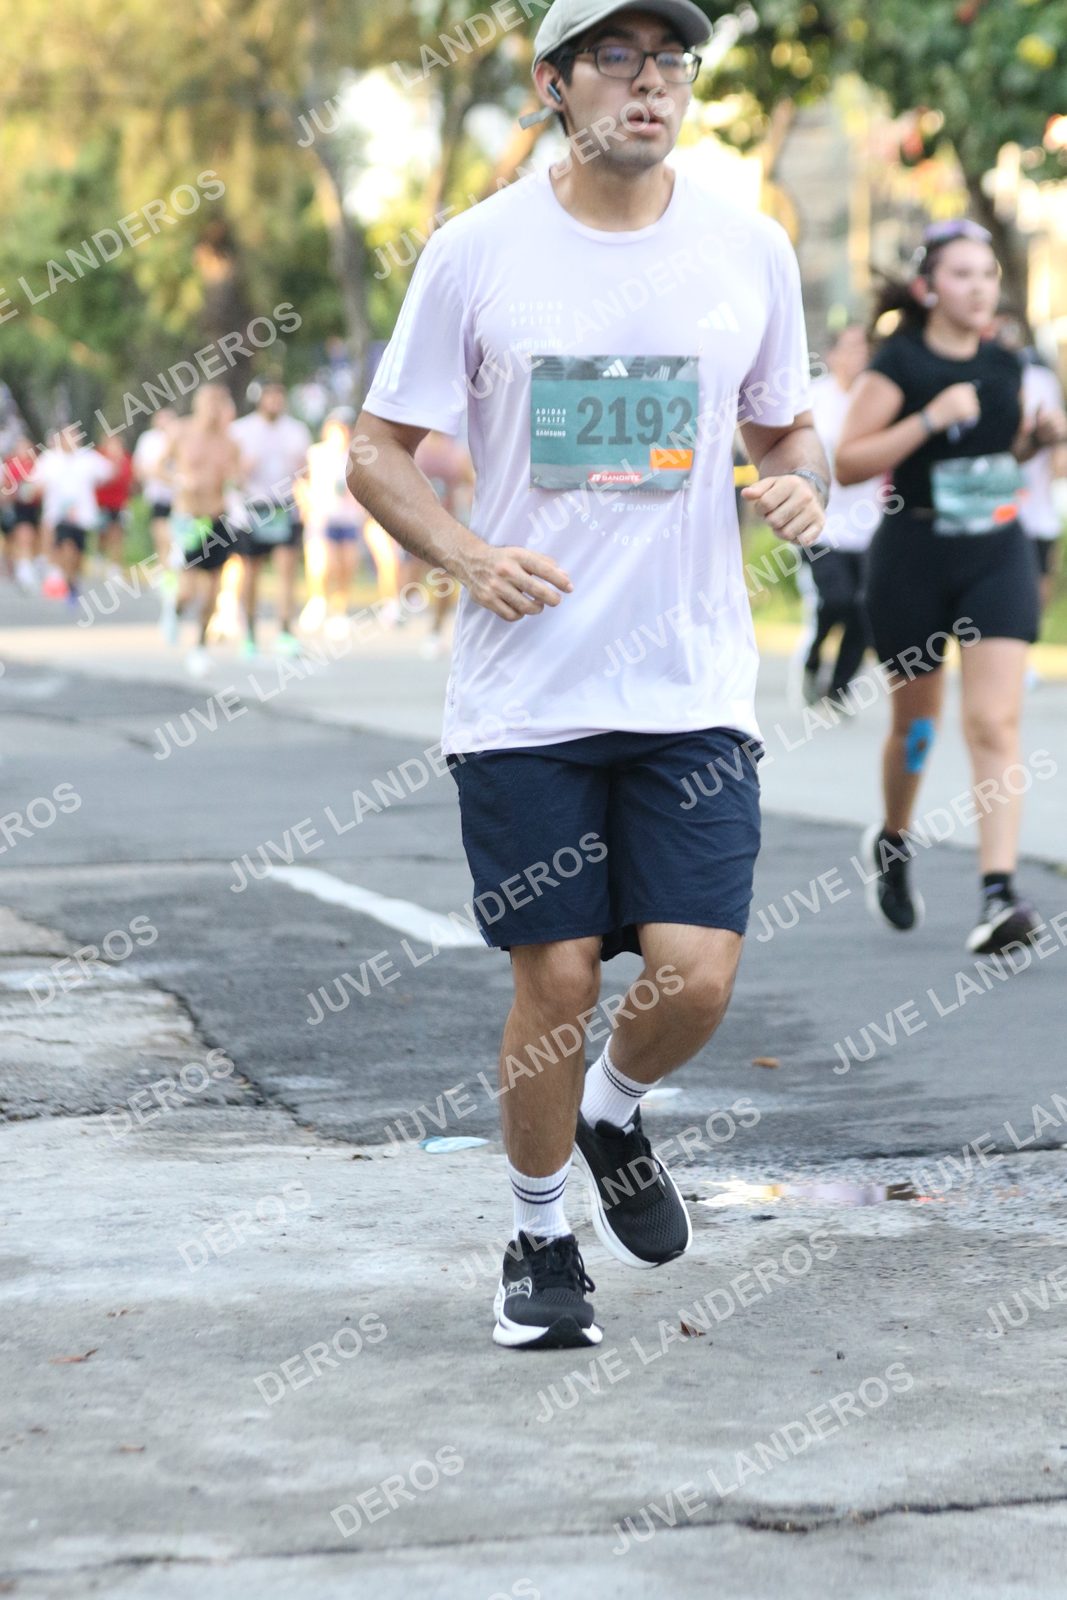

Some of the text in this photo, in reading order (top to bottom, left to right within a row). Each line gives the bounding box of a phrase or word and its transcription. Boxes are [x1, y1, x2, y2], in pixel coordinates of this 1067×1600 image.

[536, 408, 567, 416] ADIDAS
[536, 416, 566, 424] SPLITS
[576, 396, 693, 445] 2192
